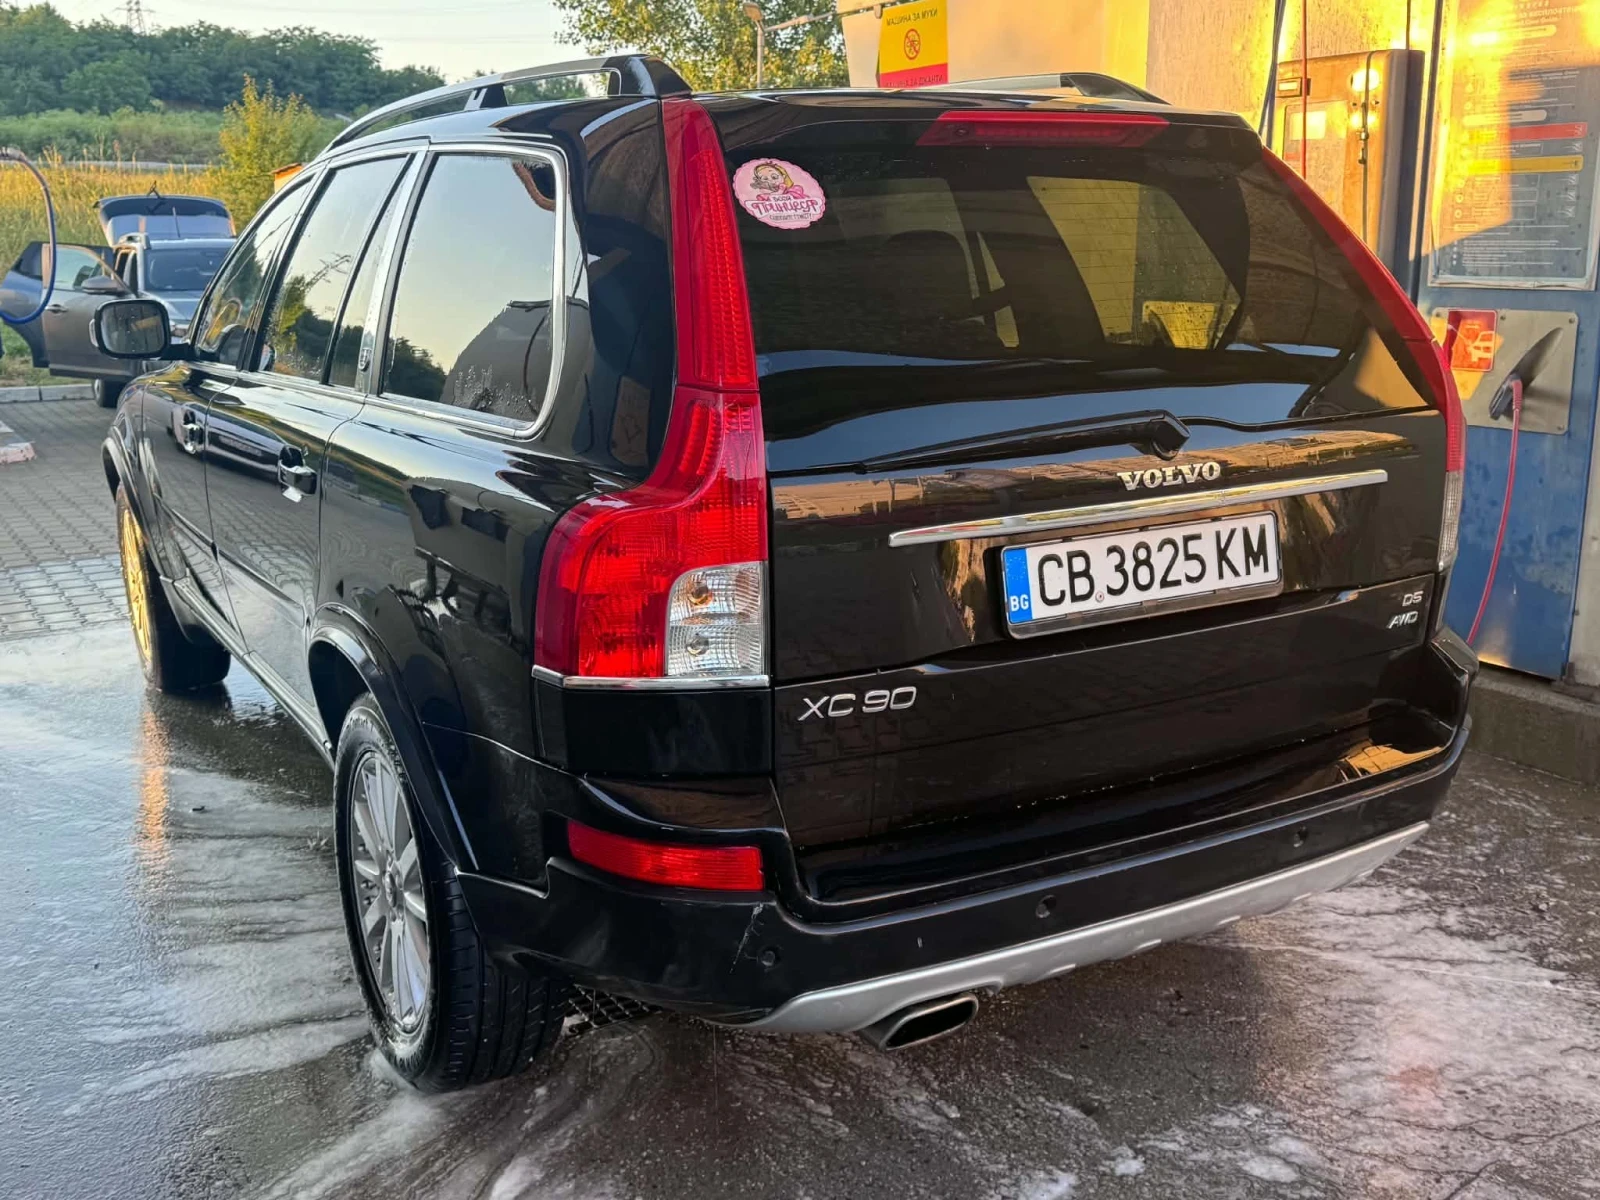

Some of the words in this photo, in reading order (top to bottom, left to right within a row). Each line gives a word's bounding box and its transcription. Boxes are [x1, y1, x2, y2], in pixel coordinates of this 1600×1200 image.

[913, 13, 921, 21] ЗА
[1117, 461, 1221, 491] VOLVO
[1010, 594, 1029, 612] BG
[1402, 590, 1424, 607] D5
